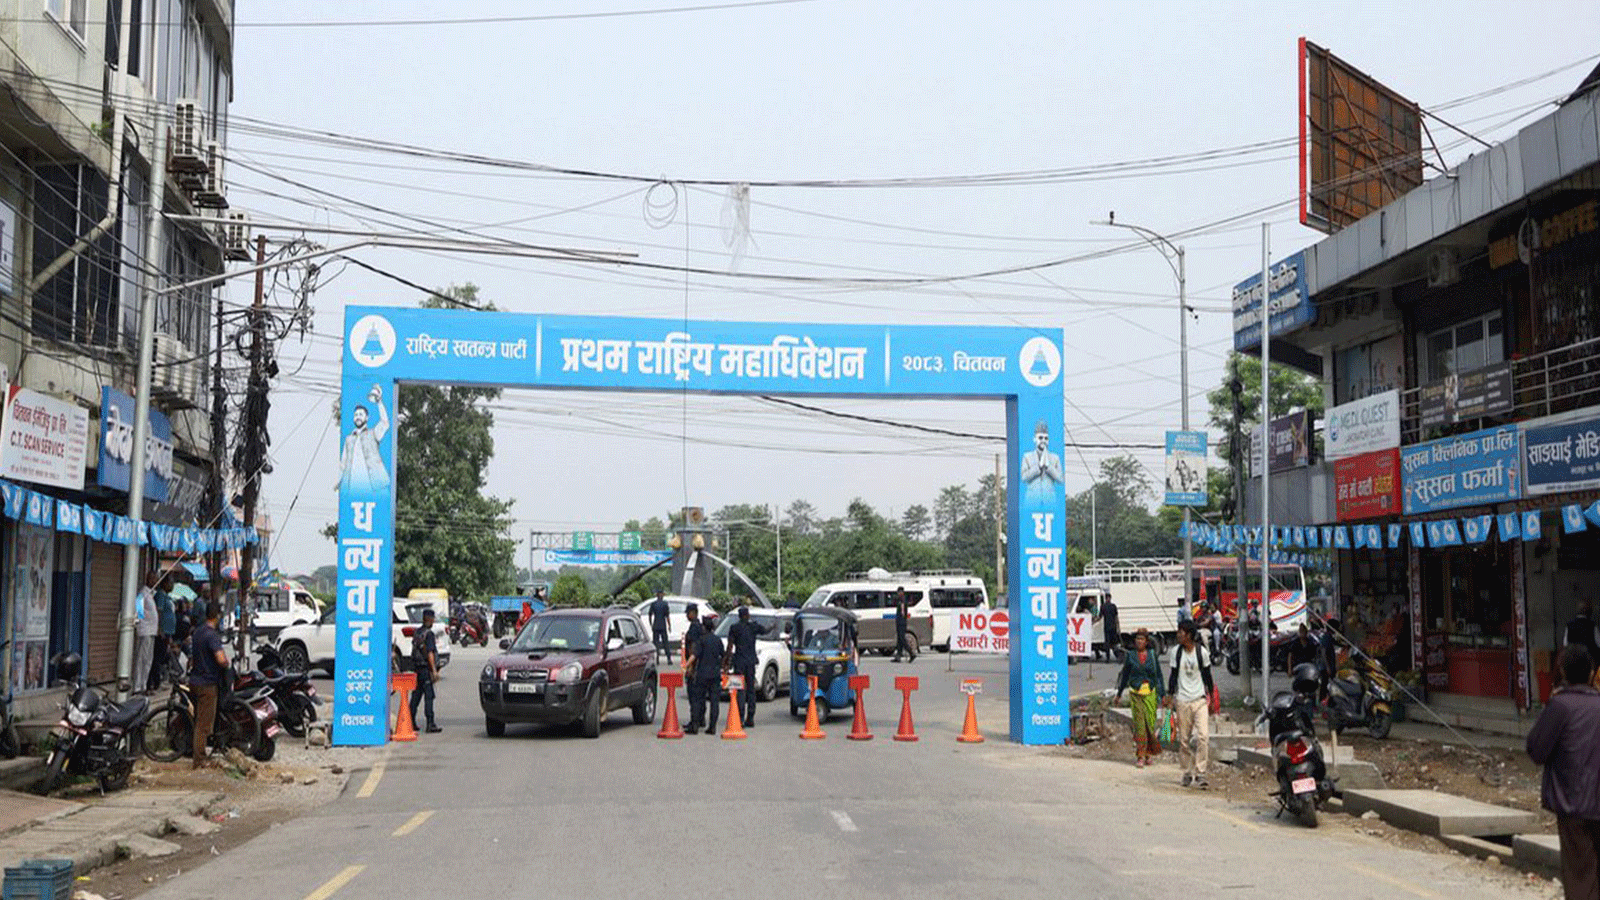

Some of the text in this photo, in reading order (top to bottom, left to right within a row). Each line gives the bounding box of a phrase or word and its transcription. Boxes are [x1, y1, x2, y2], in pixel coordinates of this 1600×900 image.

[560, 332, 867, 381] प्रथम राष्ट्रिय महाधिवेशन
[953, 350, 1007, 373] चितवन
[1361, 401, 1389, 426] QUEST
[24, 434, 41, 453] SCAN
[41, 438, 65, 458] SERVICE
[1414, 473, 1456, 504] सुसन
[959, 614, 987, 632] NO
[957, 634, 988, 650] सवारी
